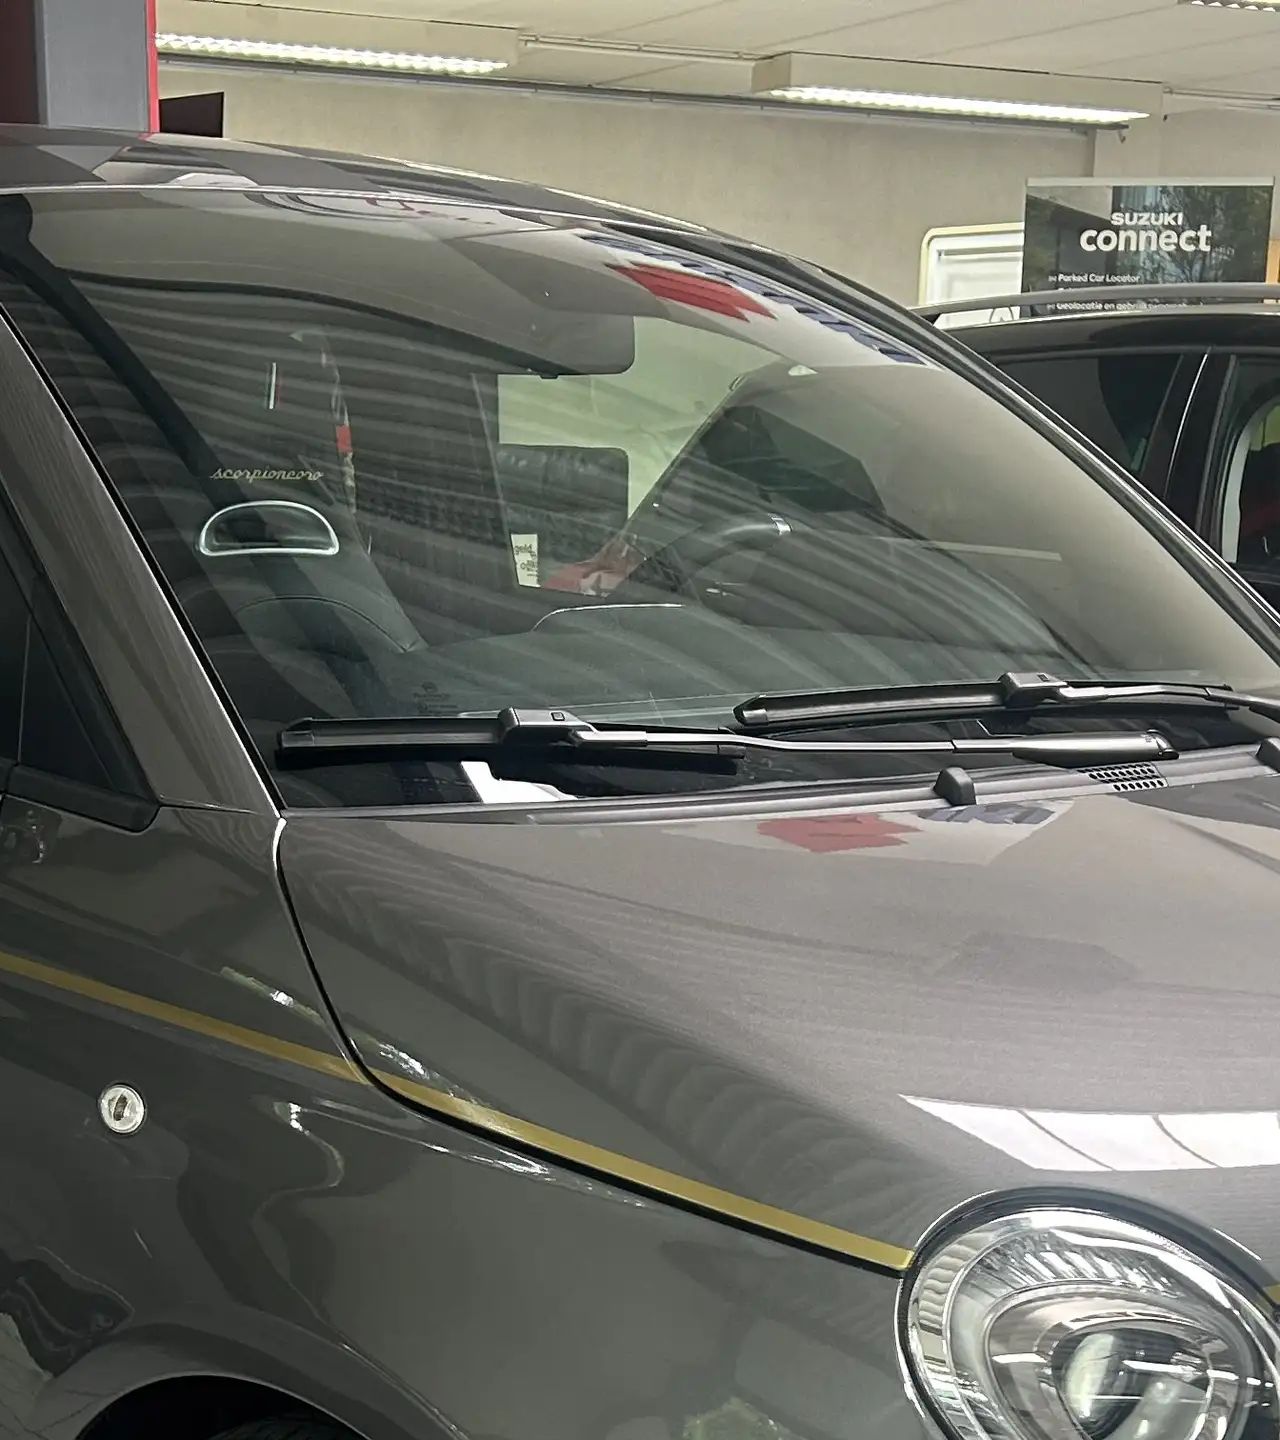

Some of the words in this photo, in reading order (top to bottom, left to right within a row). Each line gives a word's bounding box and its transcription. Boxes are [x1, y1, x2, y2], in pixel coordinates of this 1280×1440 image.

[1110, 211, 1184, 226] SUZUKI
[1079, 224, 1212, 252] connect
[1058, 273, 1088, 282] Parked
[1089, 273, 1105, 282] Car
[1105, 274, 1140, 282] Locator
[210, 464, 324, 484] scorpioneoro
